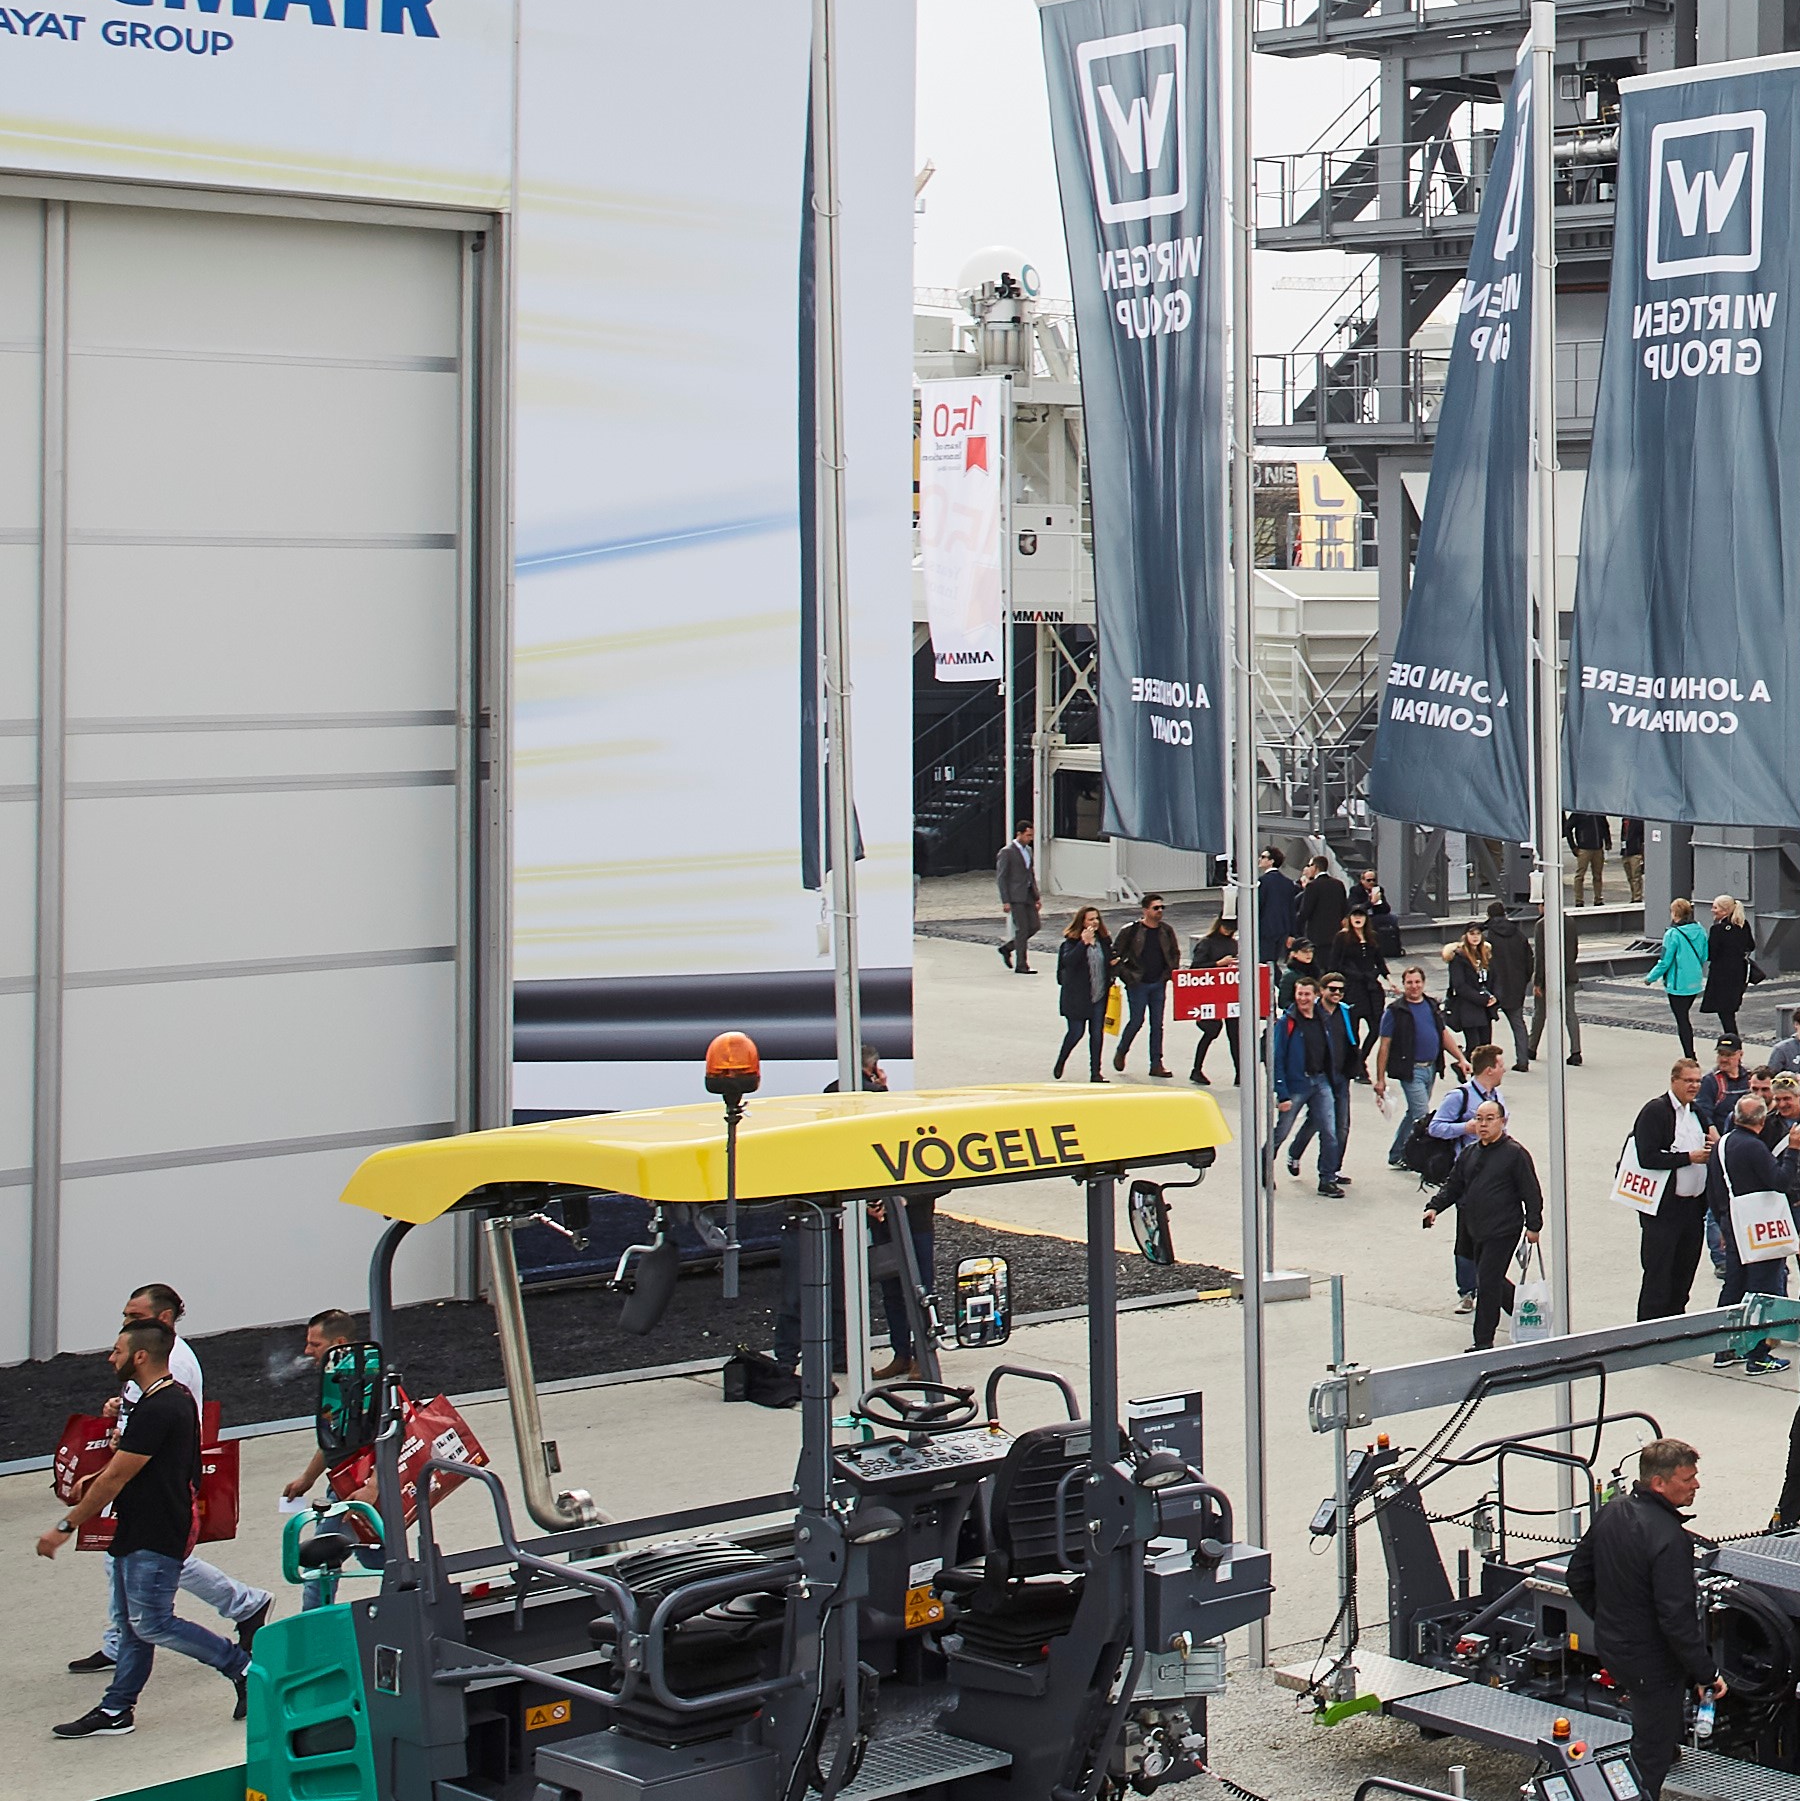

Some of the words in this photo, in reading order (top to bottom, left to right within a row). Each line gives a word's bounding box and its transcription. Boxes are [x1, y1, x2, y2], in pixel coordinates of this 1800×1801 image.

[101, 20, 234, 56] GROUP
[1003, 611, 1063, 622] MMANN
[1177, 972, 1215, 987] Block
[872, 1123, 1085, 1181] VÖGELE
[1623, 1172, 1658, 1197] PERI
[1755, 1220, 1790, 1241] PERI
